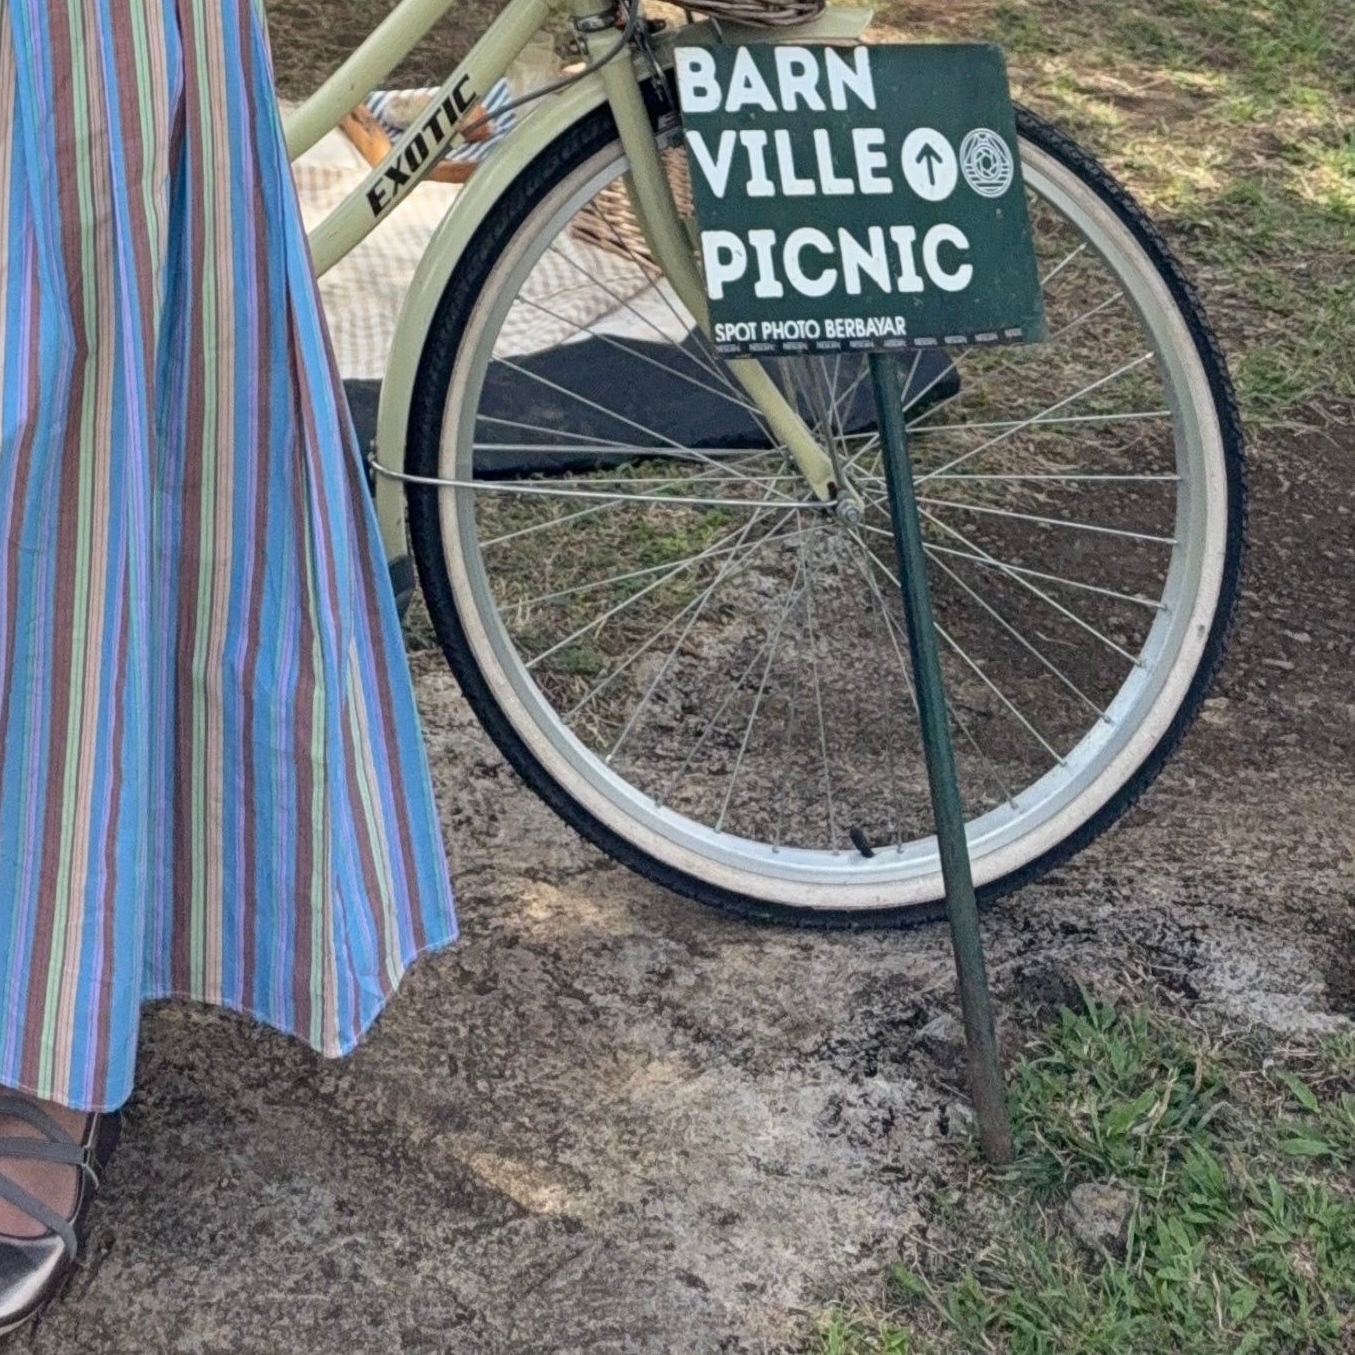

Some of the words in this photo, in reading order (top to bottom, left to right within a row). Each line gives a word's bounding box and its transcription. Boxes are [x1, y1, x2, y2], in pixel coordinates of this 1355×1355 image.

[674, 46, 877, 113] BARN
[366, 74, 476, 218] EXOTIC
[686, 128, 893, 198] VILLE
[701, 223, 973, 300] PICNIC
[714, 322, 757, 342] SPOT
[761, 319, 821, 340] PHOTO
[824, 315, 907, 339] BERBAYAR
